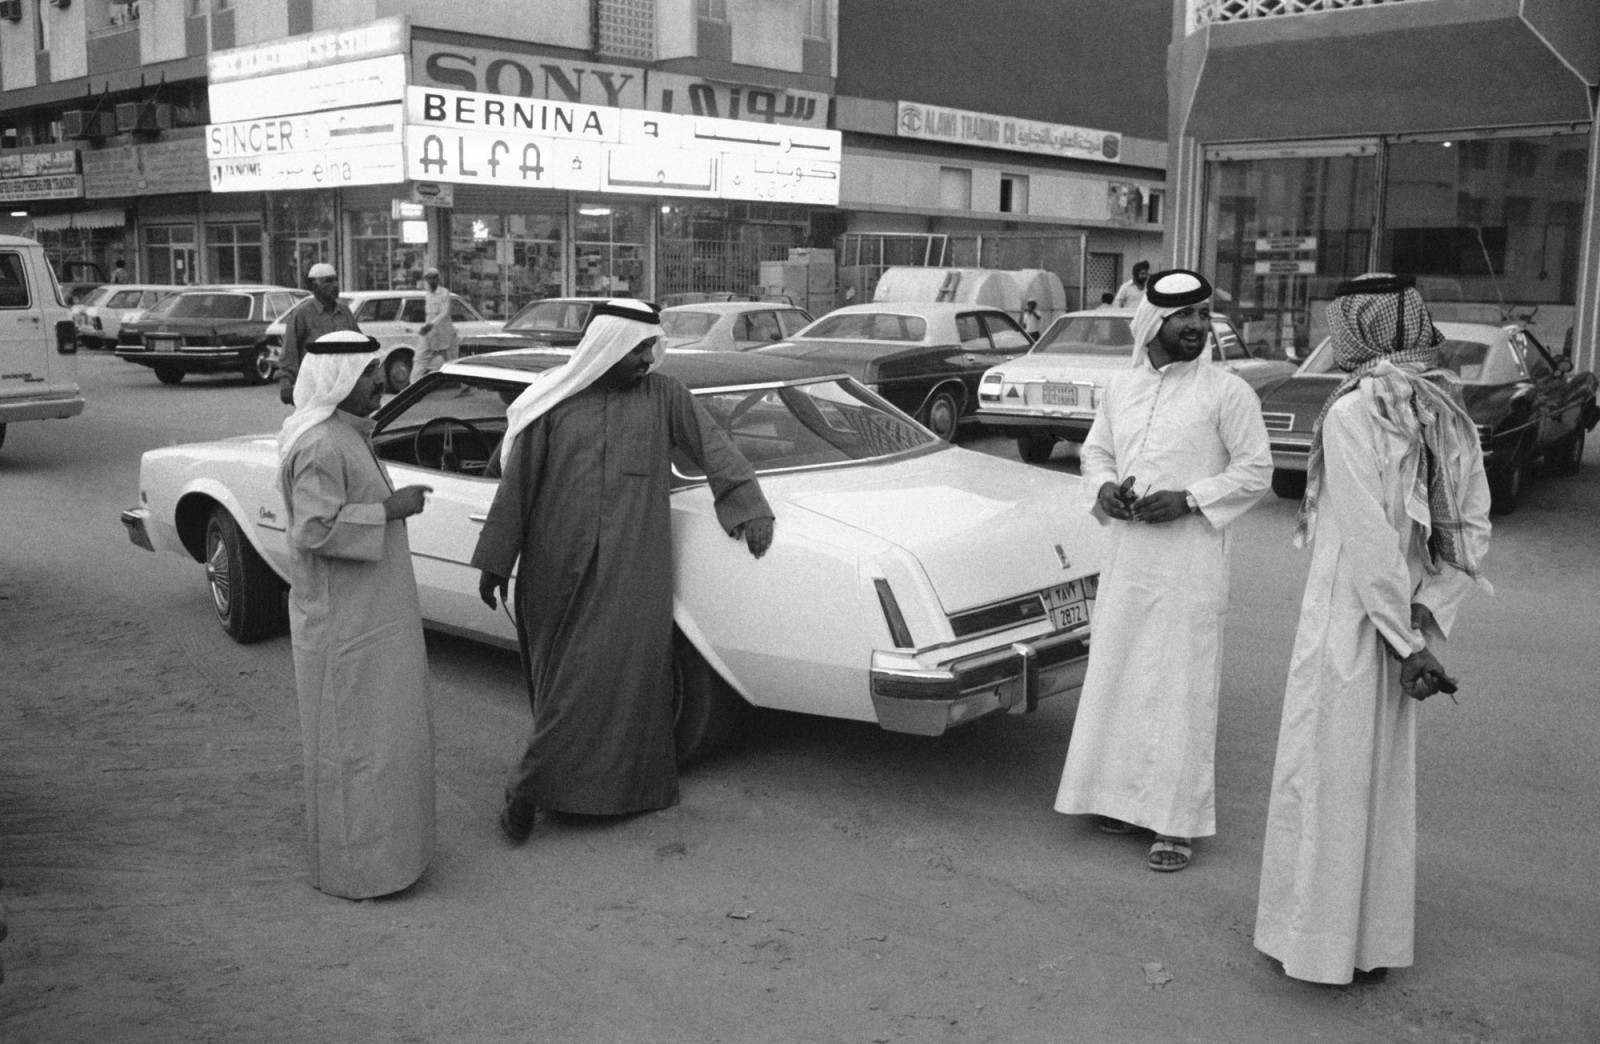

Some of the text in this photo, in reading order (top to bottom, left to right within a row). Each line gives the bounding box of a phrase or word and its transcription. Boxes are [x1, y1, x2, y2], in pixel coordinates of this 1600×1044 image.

[426, 52, 634, 107] SONY
[424, 92, 603, 136] BERNINA
[961, 115, 1000, 143] TRADING
[1060, 606, 1082, 627] 2872
